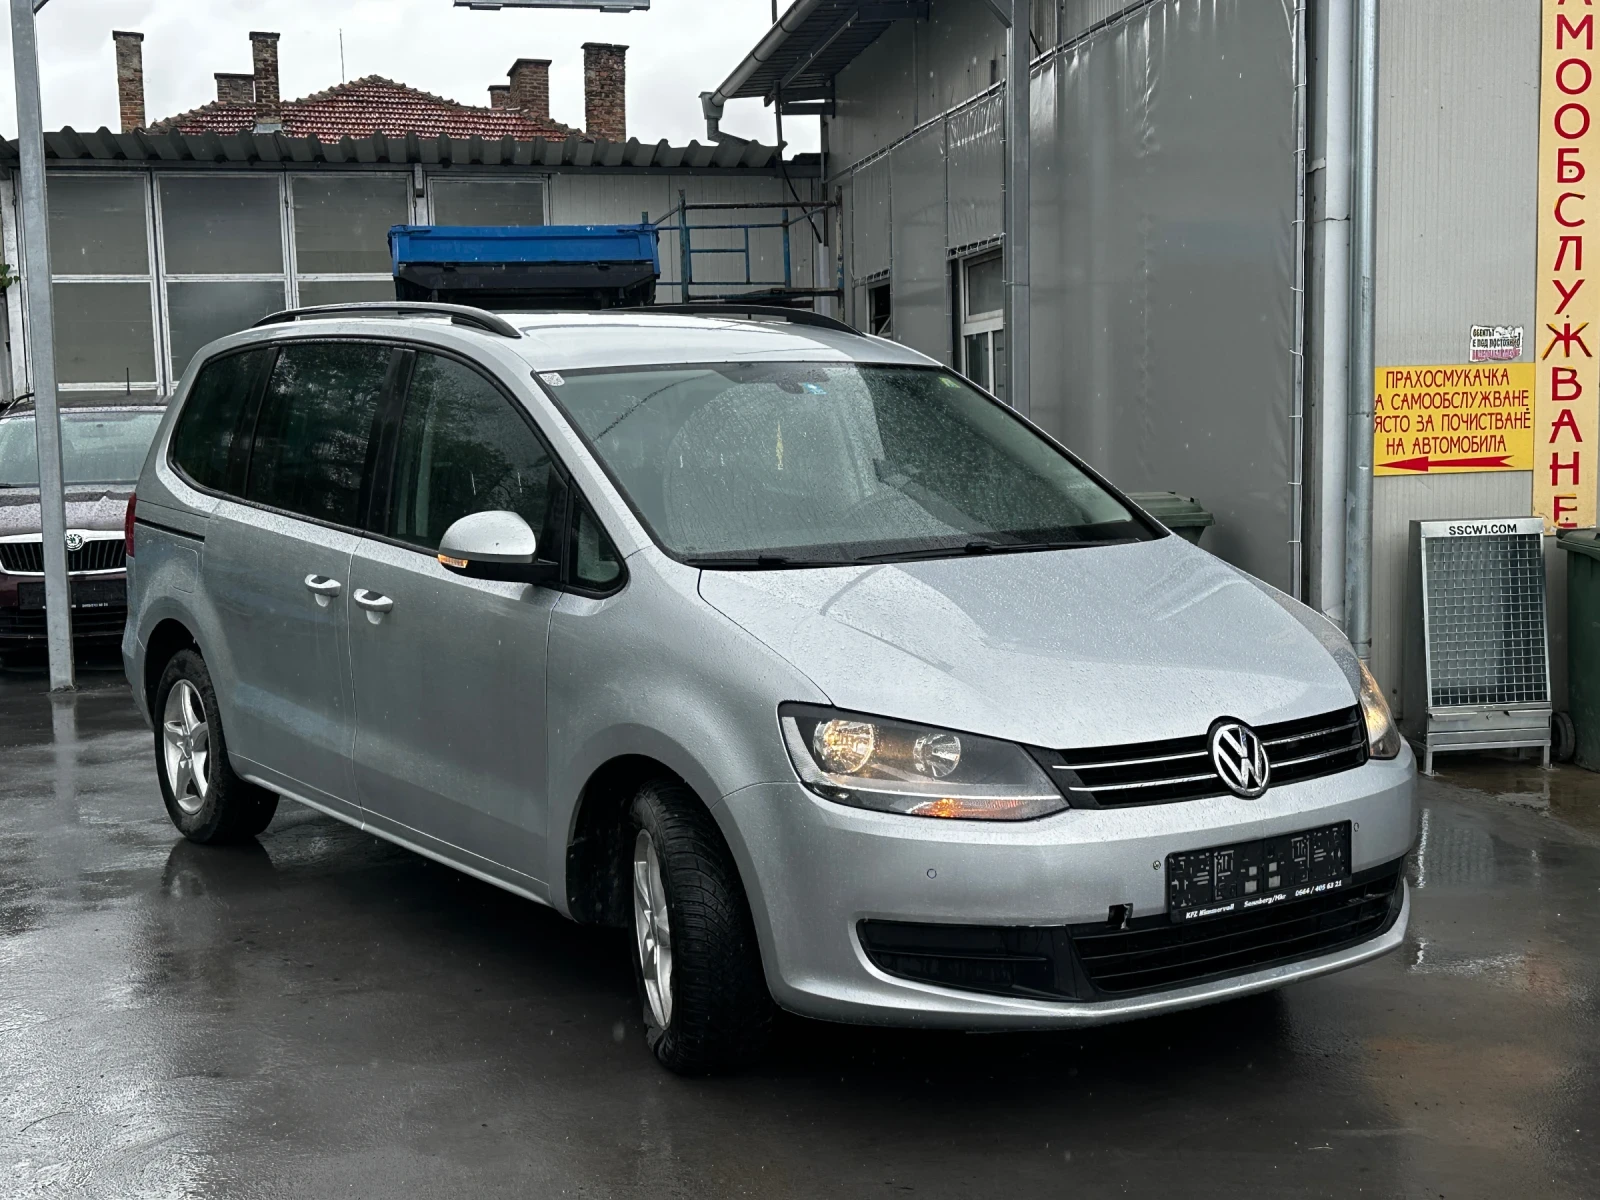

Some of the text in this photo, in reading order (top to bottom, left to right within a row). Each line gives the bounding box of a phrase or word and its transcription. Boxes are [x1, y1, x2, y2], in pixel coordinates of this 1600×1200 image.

[1541, 0, 1594, 528] МООБСЛУЖВАНЕ
[1385, 368, 1511, 389] ПРАХОСМУКАЧКА
[1374, 389, 1530, 412] А САМООБСЛУЖВАНЕ
[1374, 411, 1532, 434] ЯСТО ЗА ПОЧИСТВАНЕ
[1386, 434, 1508, 456] НА АВТОМОБИЛА
[1448, 523, 1518, 536] SSCW1.COM
